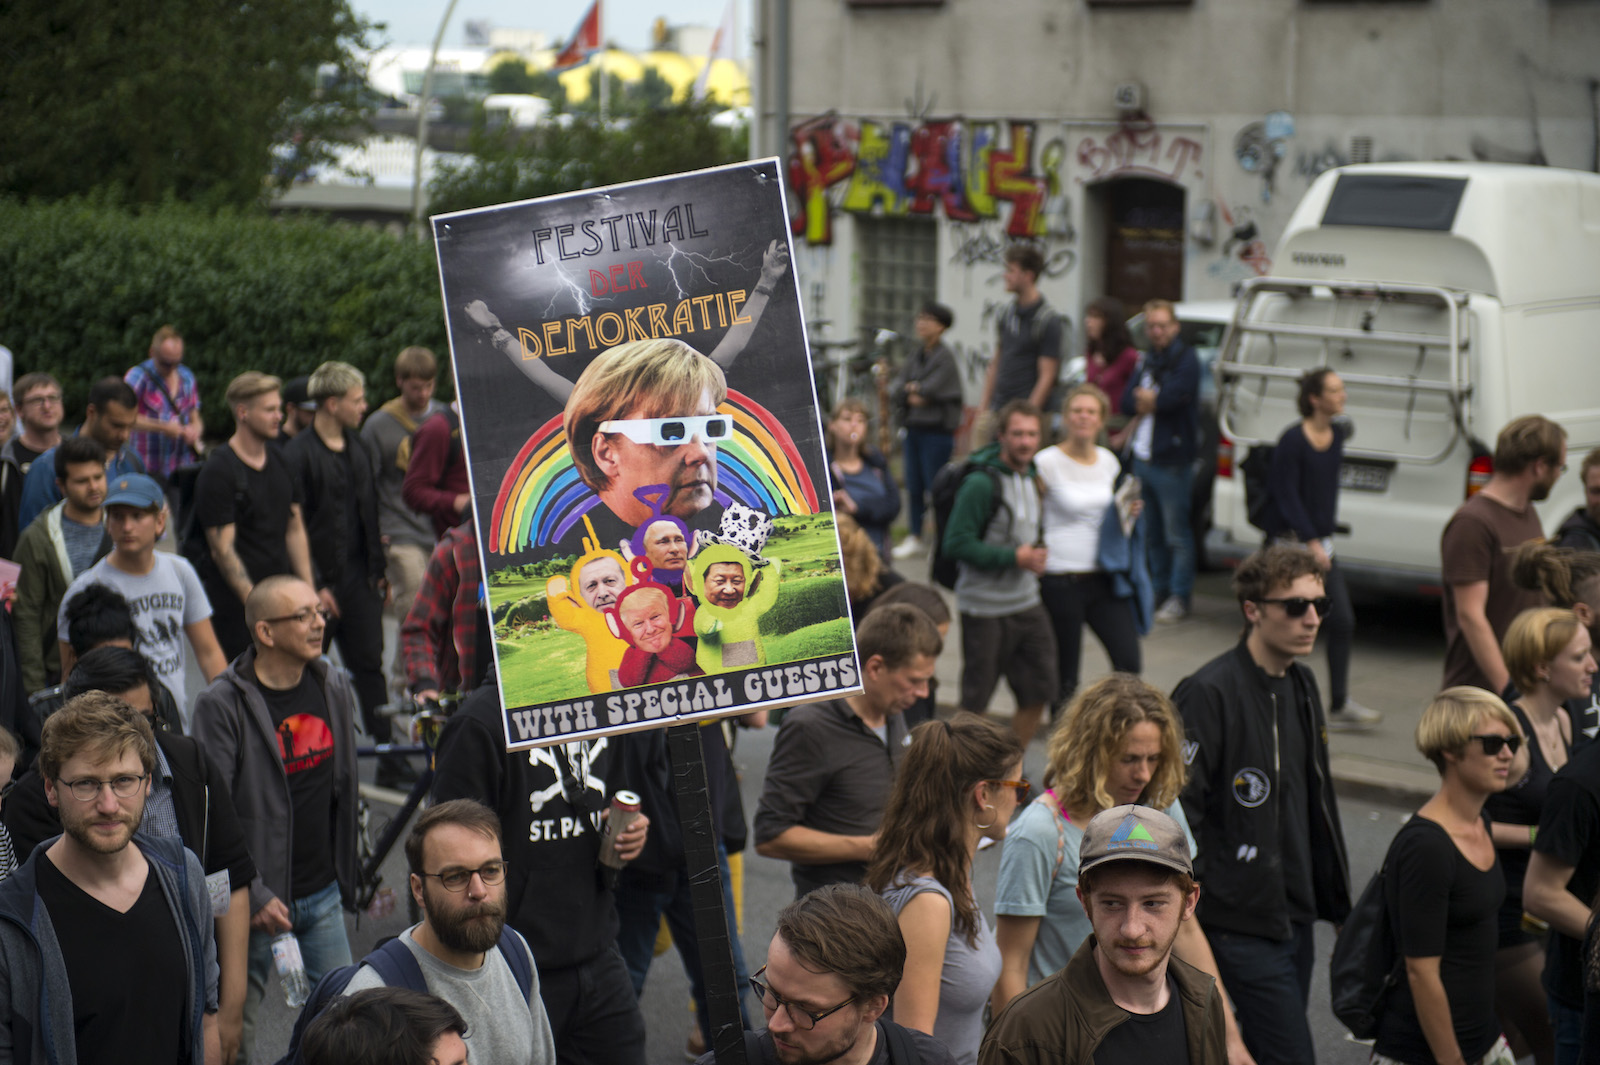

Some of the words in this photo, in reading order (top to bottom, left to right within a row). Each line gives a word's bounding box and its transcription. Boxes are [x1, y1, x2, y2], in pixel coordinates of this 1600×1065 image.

[532, 203, 709, 265] FESTIVAL
[588, 260, 649, 297] DER
[517, 289, 752, 361] DEMOKRATIE
[511, 699, 599, 741] WITH
[606, 678, 734, 726] SPECIAL
[743, 656, 858, 703] GUESTS
[529, 819, 558, 843] ST.
[560, 809, 603, 840] PAU
